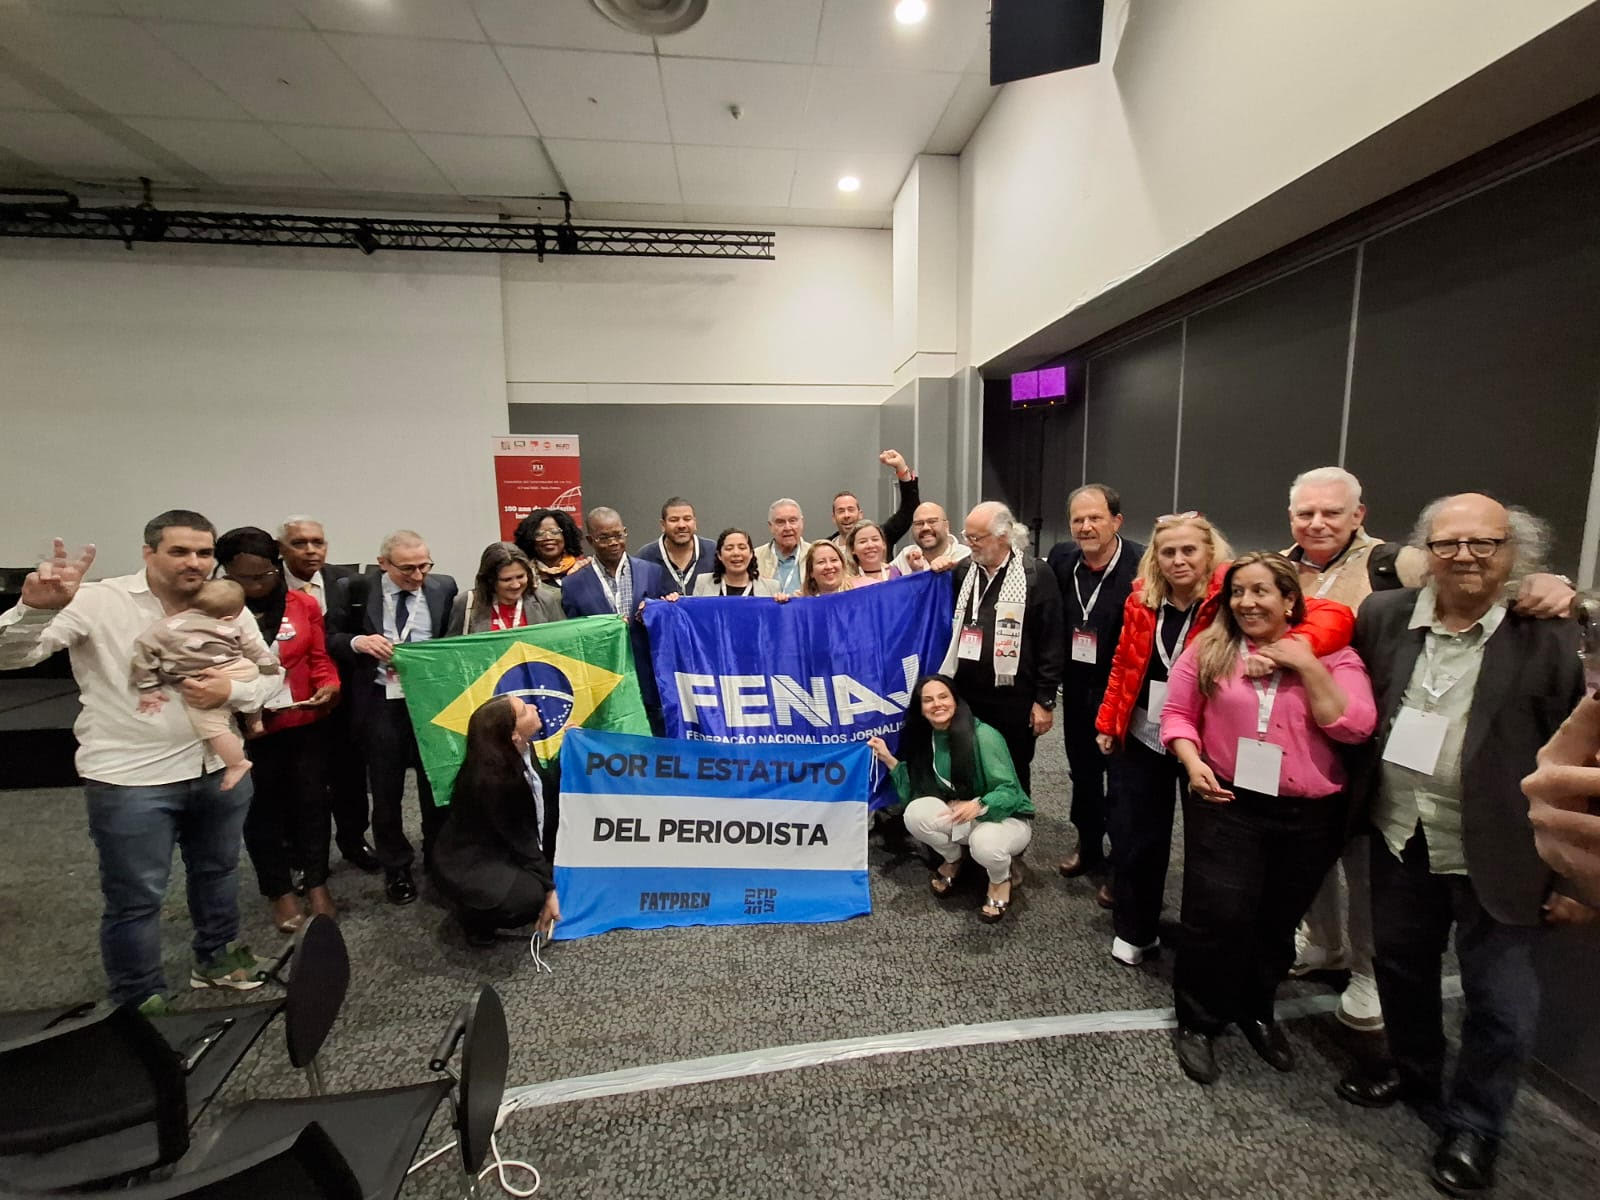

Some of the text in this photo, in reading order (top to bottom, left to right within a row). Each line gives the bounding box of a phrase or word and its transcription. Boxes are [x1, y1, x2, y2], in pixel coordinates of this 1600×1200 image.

[674, 653, 920, 727] FENAJ
[686, 729, 755, 744] FEDERAÇÃO
[758, 734, 820, 744] NACIONAL
[821, 733, 847, 744] DOS
[585, 751, 847, 786] POR EL ESTATUTO
[593, 817, 829, 846] DEL PERIODISTA
[640, 891, 711, 911] FATPREN
